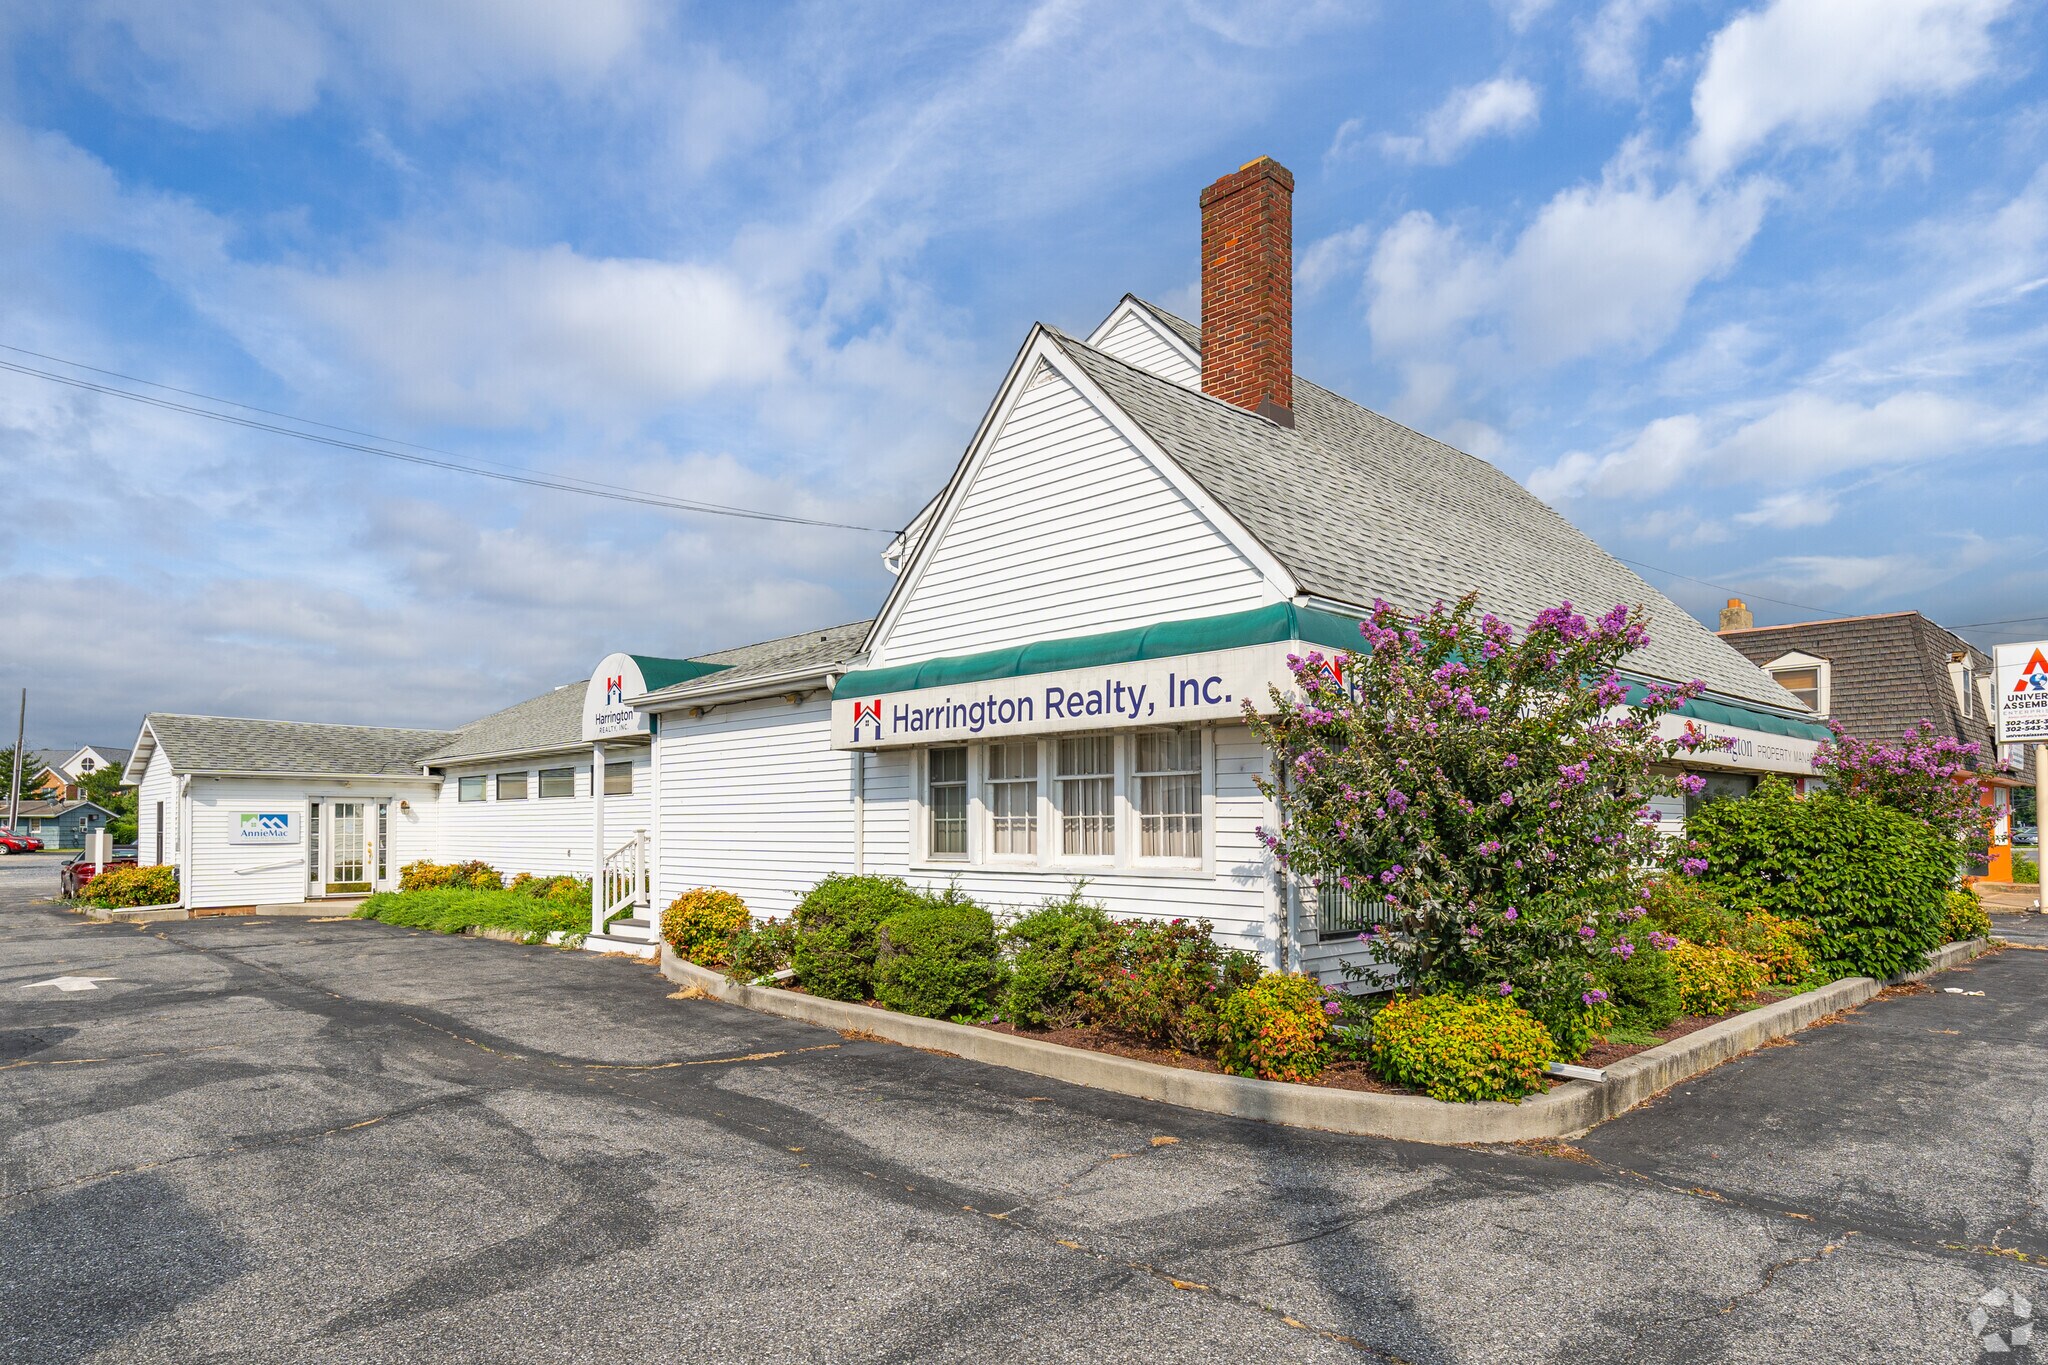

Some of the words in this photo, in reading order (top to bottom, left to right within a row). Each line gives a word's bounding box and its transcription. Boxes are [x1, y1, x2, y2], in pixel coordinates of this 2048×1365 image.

[892, 695, 1034, 734] Harrington
[1045, 679, 1155, 720] Realty,
[1168, 673, 1232, 708] Inc.
[2003, 701, 2048, 709] ASSEMB
[596, 710, 633, 724] Harrington
[599, 725, 618, 733] REALTY,
[1757, 744, 1793, 762] PROPERTY
